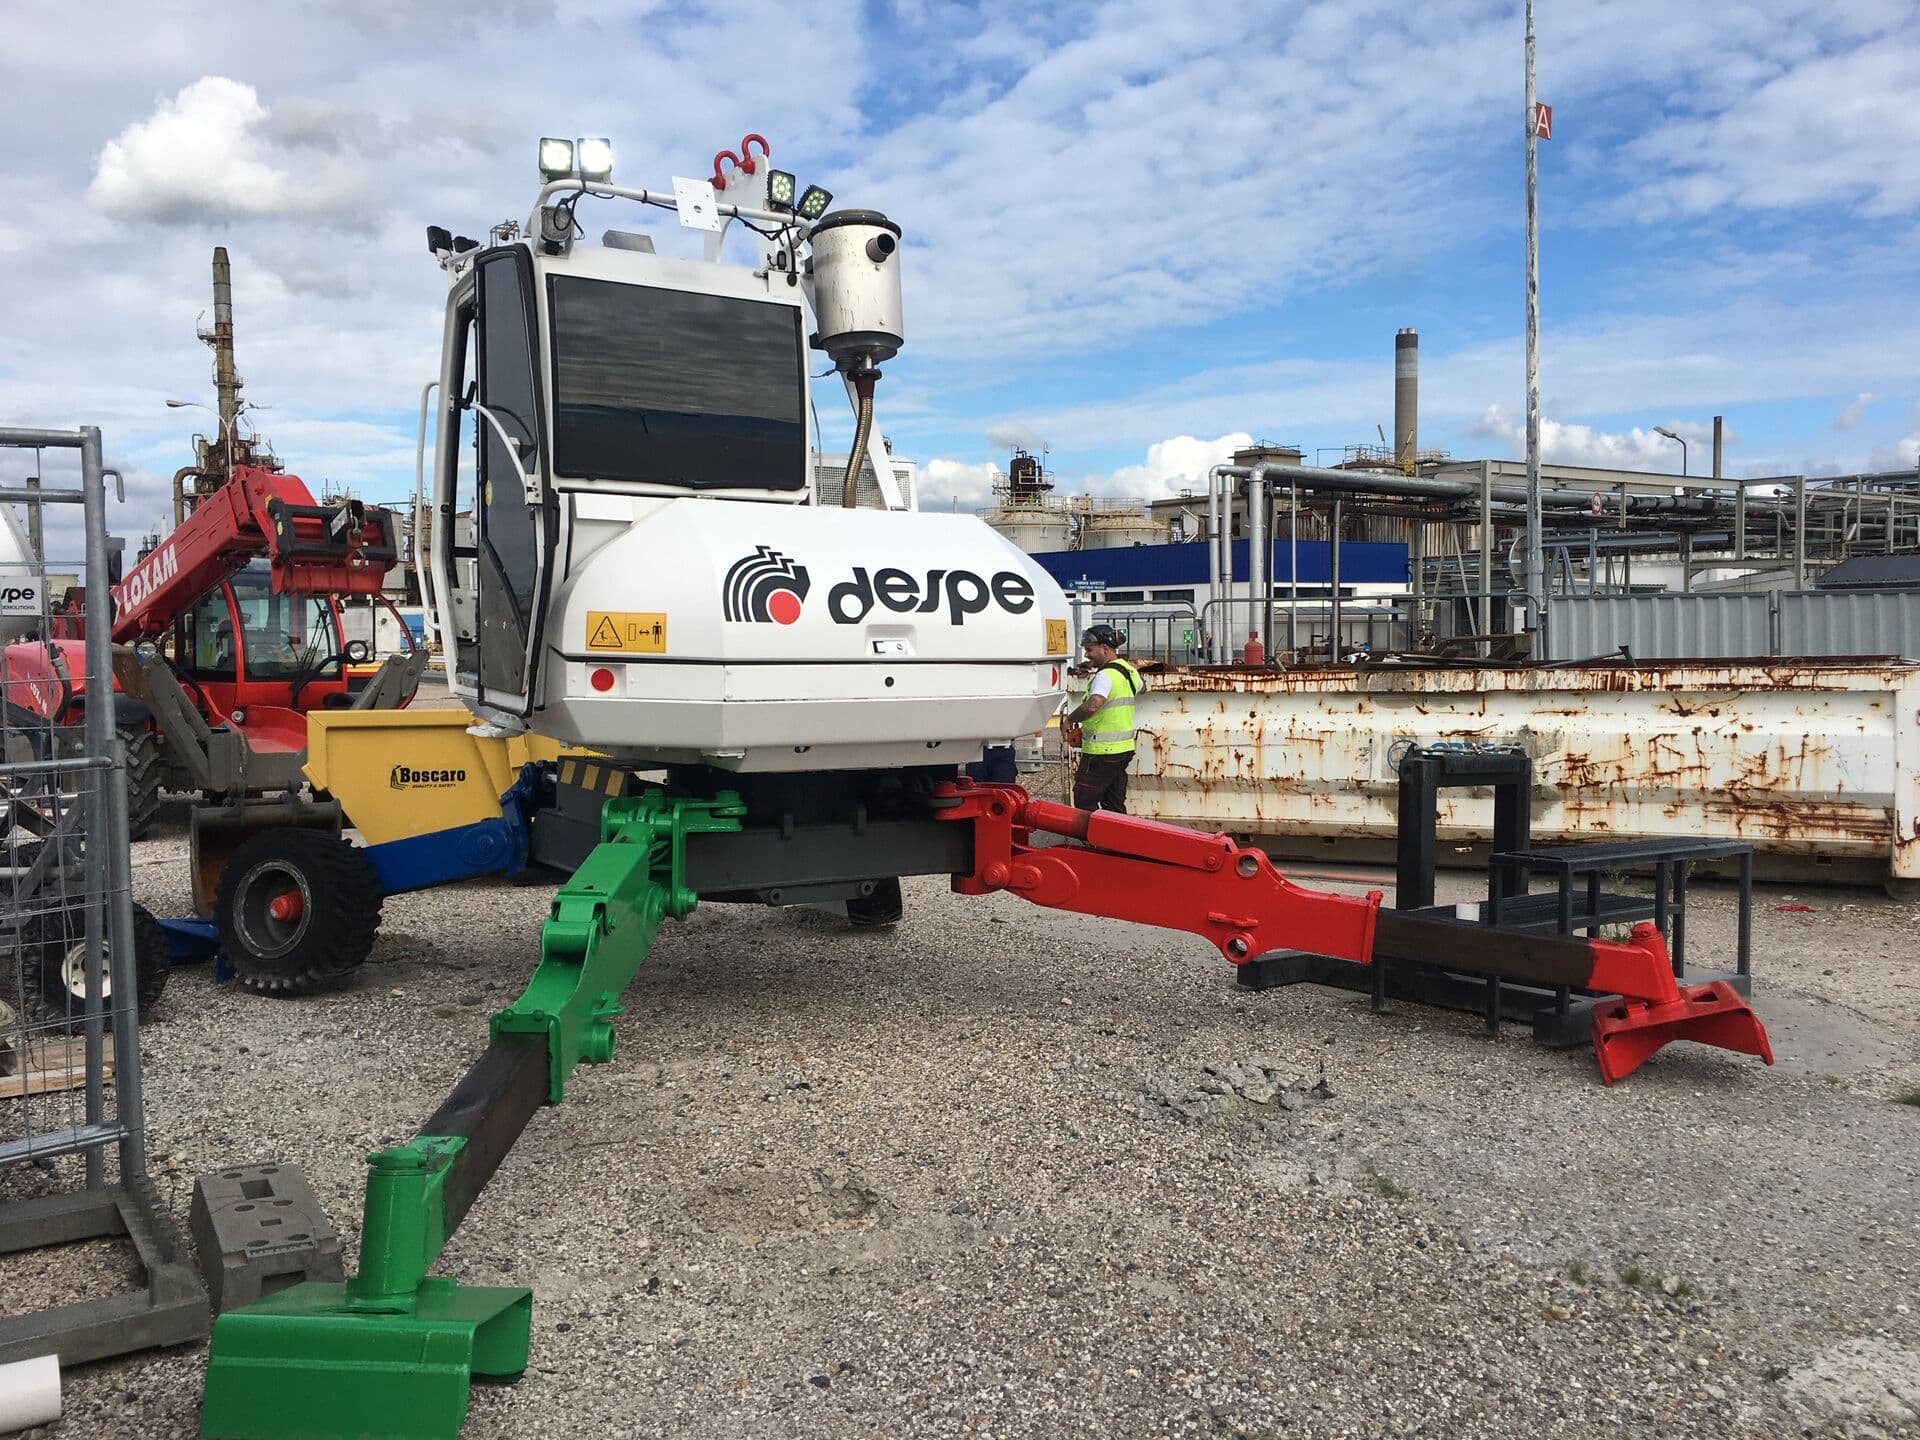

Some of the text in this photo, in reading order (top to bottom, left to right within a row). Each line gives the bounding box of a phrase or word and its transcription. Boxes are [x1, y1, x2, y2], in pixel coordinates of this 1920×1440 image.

[1536, 105, 1551, 139] A
[122, 543, 178, 614] LOXAM
[828, 567, 1035, 625] despe
[400, 767, 466, 783] Boscaro
